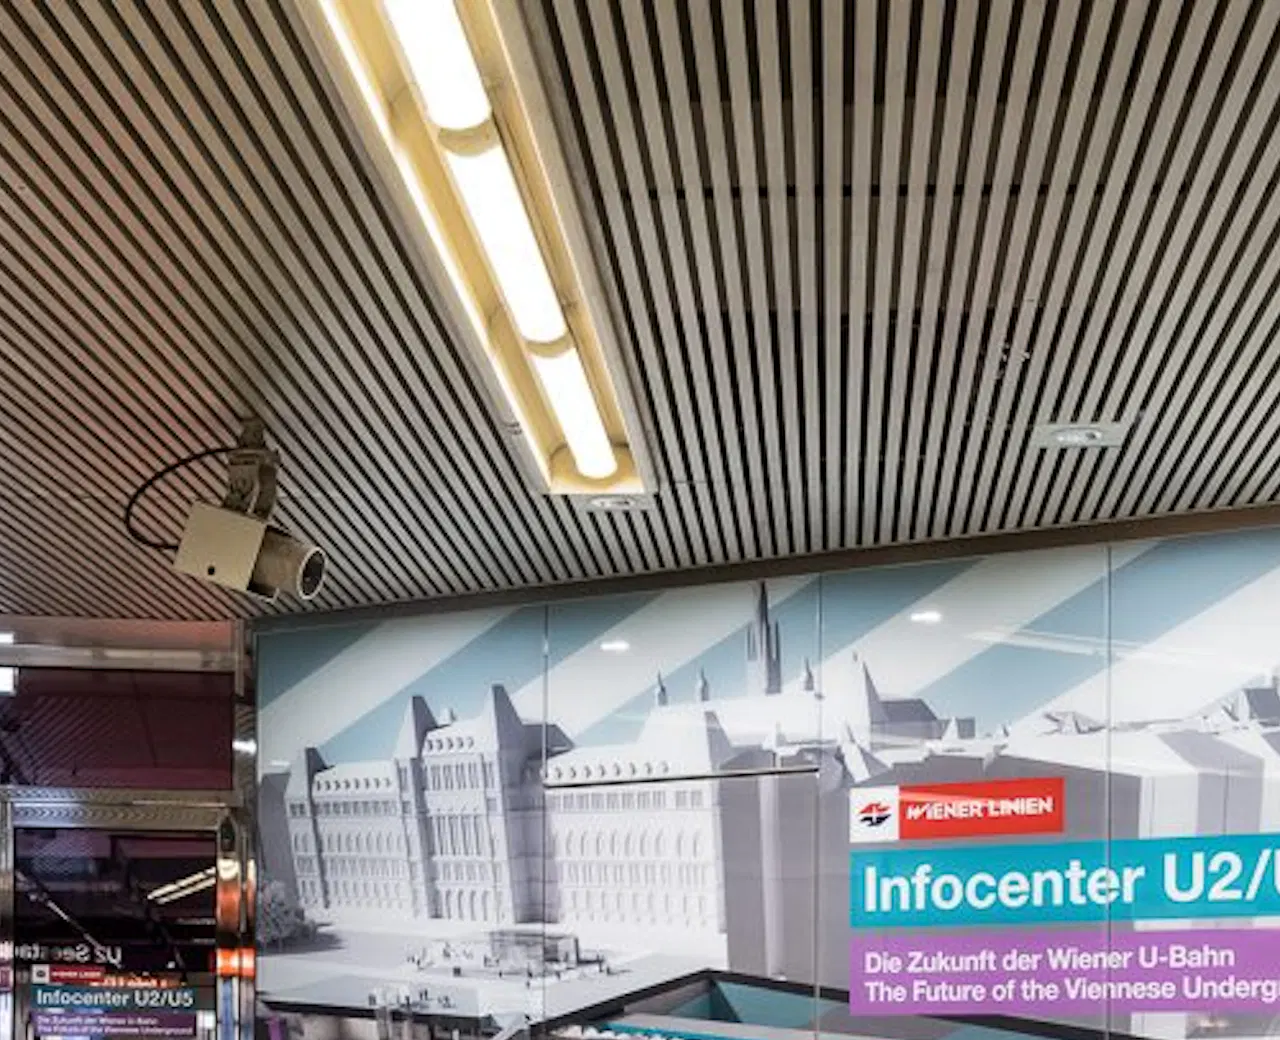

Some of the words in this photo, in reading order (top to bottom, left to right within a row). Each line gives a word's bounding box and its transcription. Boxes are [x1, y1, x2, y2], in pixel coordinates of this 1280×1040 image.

[906, 800, 982, 820] WIENER
[987, 797, 1054, 816] LINIEN
[864, 859, 1145, 912] Infocenter
[864, 951, 902, 974] Die
[907, 949, 997, 973] Zukunft
[1002, 948, 1043, 972] der
[1047, 948, 1132, 971] Wiener
[1138, 945, 1236, 969] U-Bahn
[36, 988, 130, 1006] Infocenter
[134, 989, 194, 1008] U2/U5
[864, 980, 907, 1002] The
[913, 979, 986, 1002] Future
[992, 979, 1017, 1001] of
[1022, 978, 1060, 1000] the
[1064, 977, 1176, 1000] Viennese
